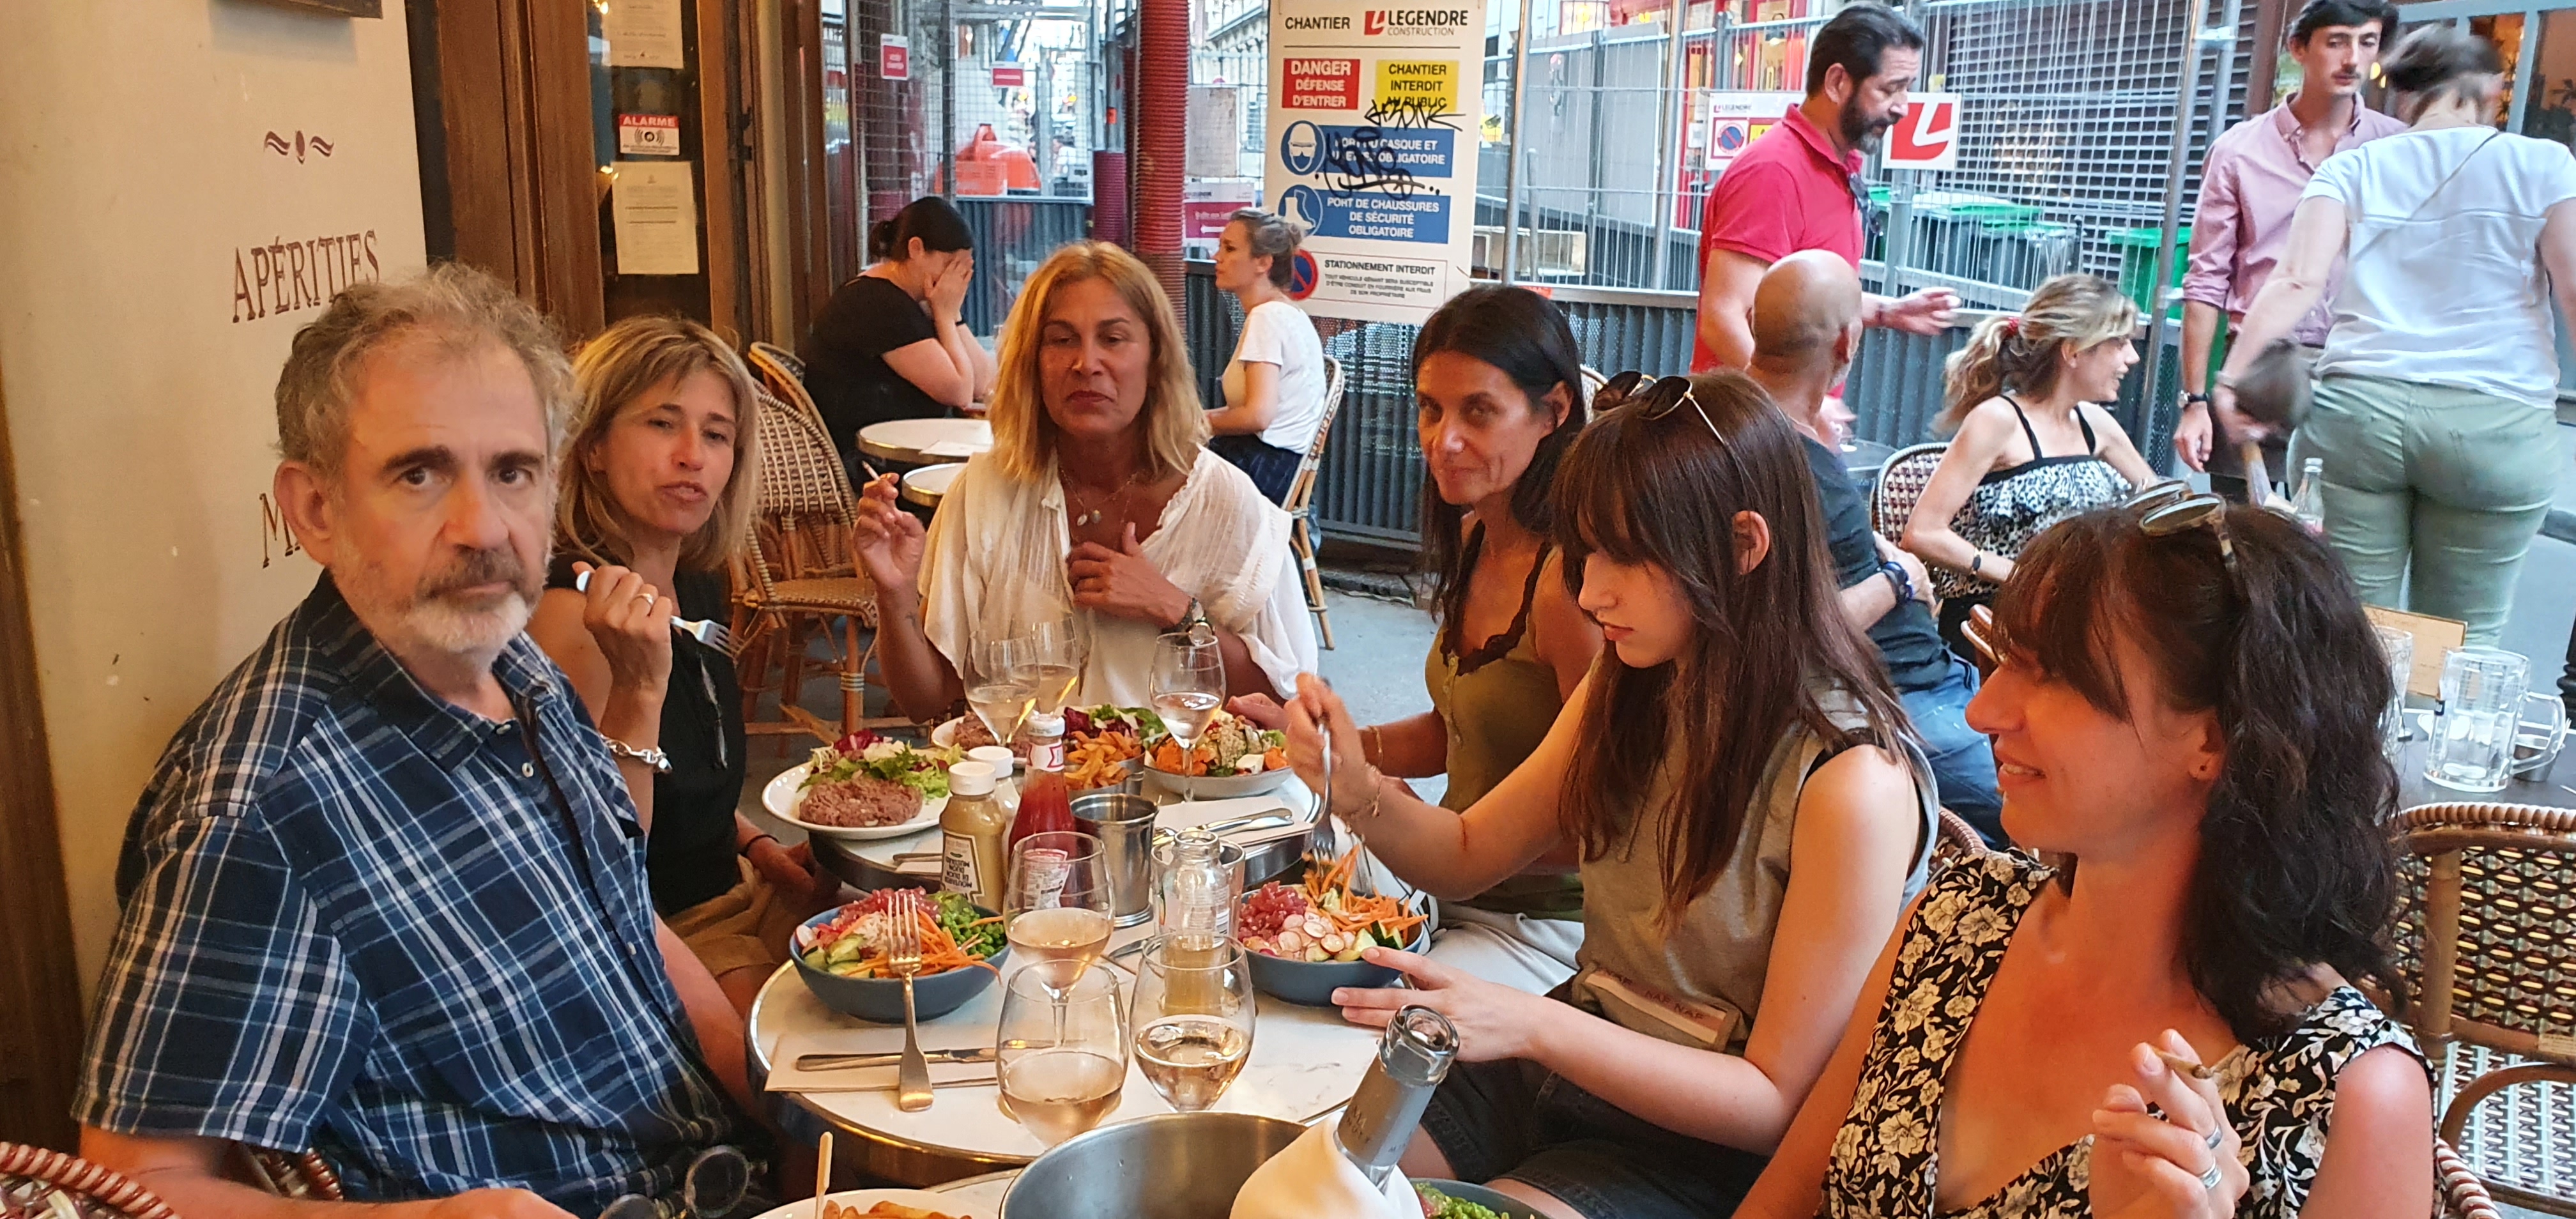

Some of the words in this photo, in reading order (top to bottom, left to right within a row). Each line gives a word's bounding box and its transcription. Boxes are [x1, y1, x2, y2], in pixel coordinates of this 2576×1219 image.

[1285, 17, 1351, 29] CHANTIER
[1388, 10, 1469, 26] LEGENDRE
[1387, 27, 1455, 36] CONSTRUCTION
[1291, 61, 1352, 75] DANGER
[1388, 63, 1447, 75] CHANTIER
[1295, 77, 1346, 91] DÉFENSE
[1390, 80, 1444, 91] INTERDIT
[1292, 95, 1347, 107] D'ENTRER
[1405, 97, 1447, 108] PUBLIC
[623, 116, 675, 127] ALARME
[1379, 139, 1423, 151] CASQUE
[1424, 140, 1438, 151] ET
[1327, 197, 1353, 208] PORT
[1355, 198, 1368, 209] DE
[1370, 199, 1440, 213] CHAUSSURES
[1349, 211, 1363, 222] DE
[1365, 211, 1414, 225] SÉCURITÉ
[1349, 226, 1414, 238] OBLIGATOIRE
[1324, 259, 1394, 272] STATIONNEMENT
[1395, 265, 1436, 275] INTERDIT
